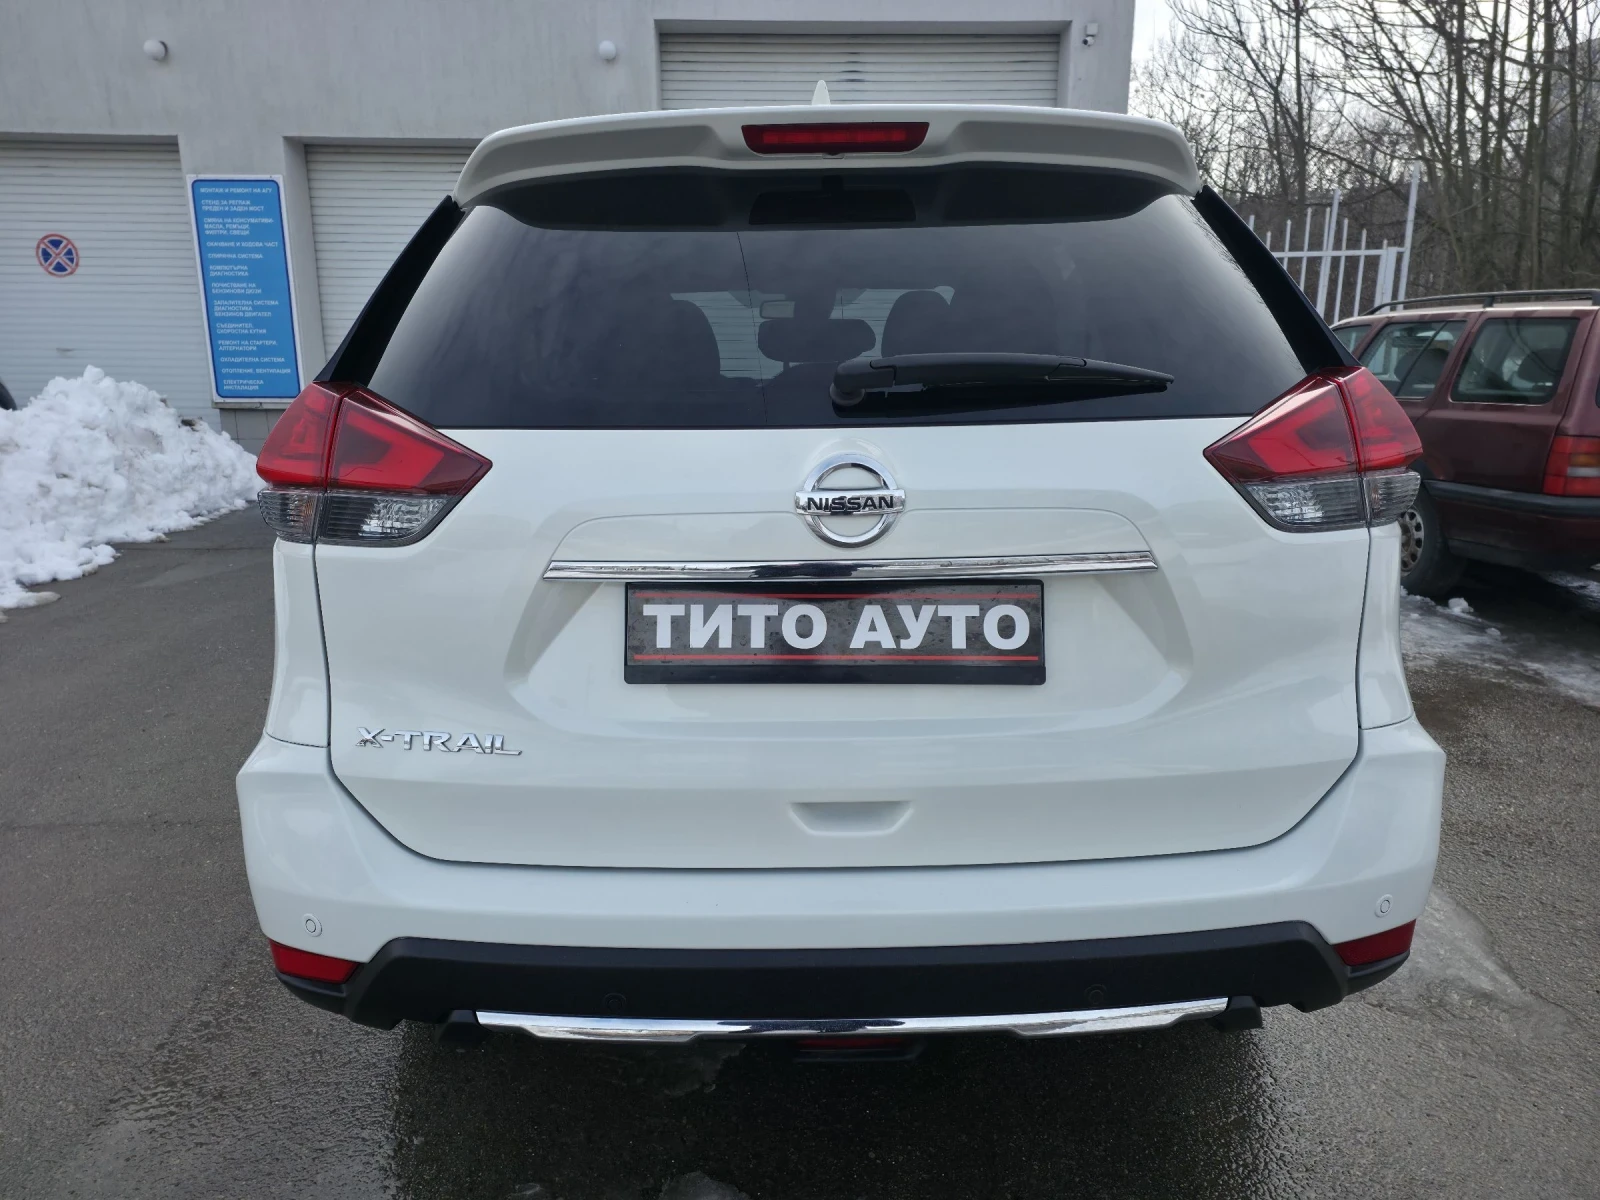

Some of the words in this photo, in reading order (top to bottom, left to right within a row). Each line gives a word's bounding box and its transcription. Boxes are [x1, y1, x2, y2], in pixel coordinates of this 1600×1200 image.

[807, 496, 894, 511] NISSAN
[643, 604, 827, 650] ТИТО
[849, 604, 1030, 650] АУТО
[356, 727, 522, 756] X-TRAIL
